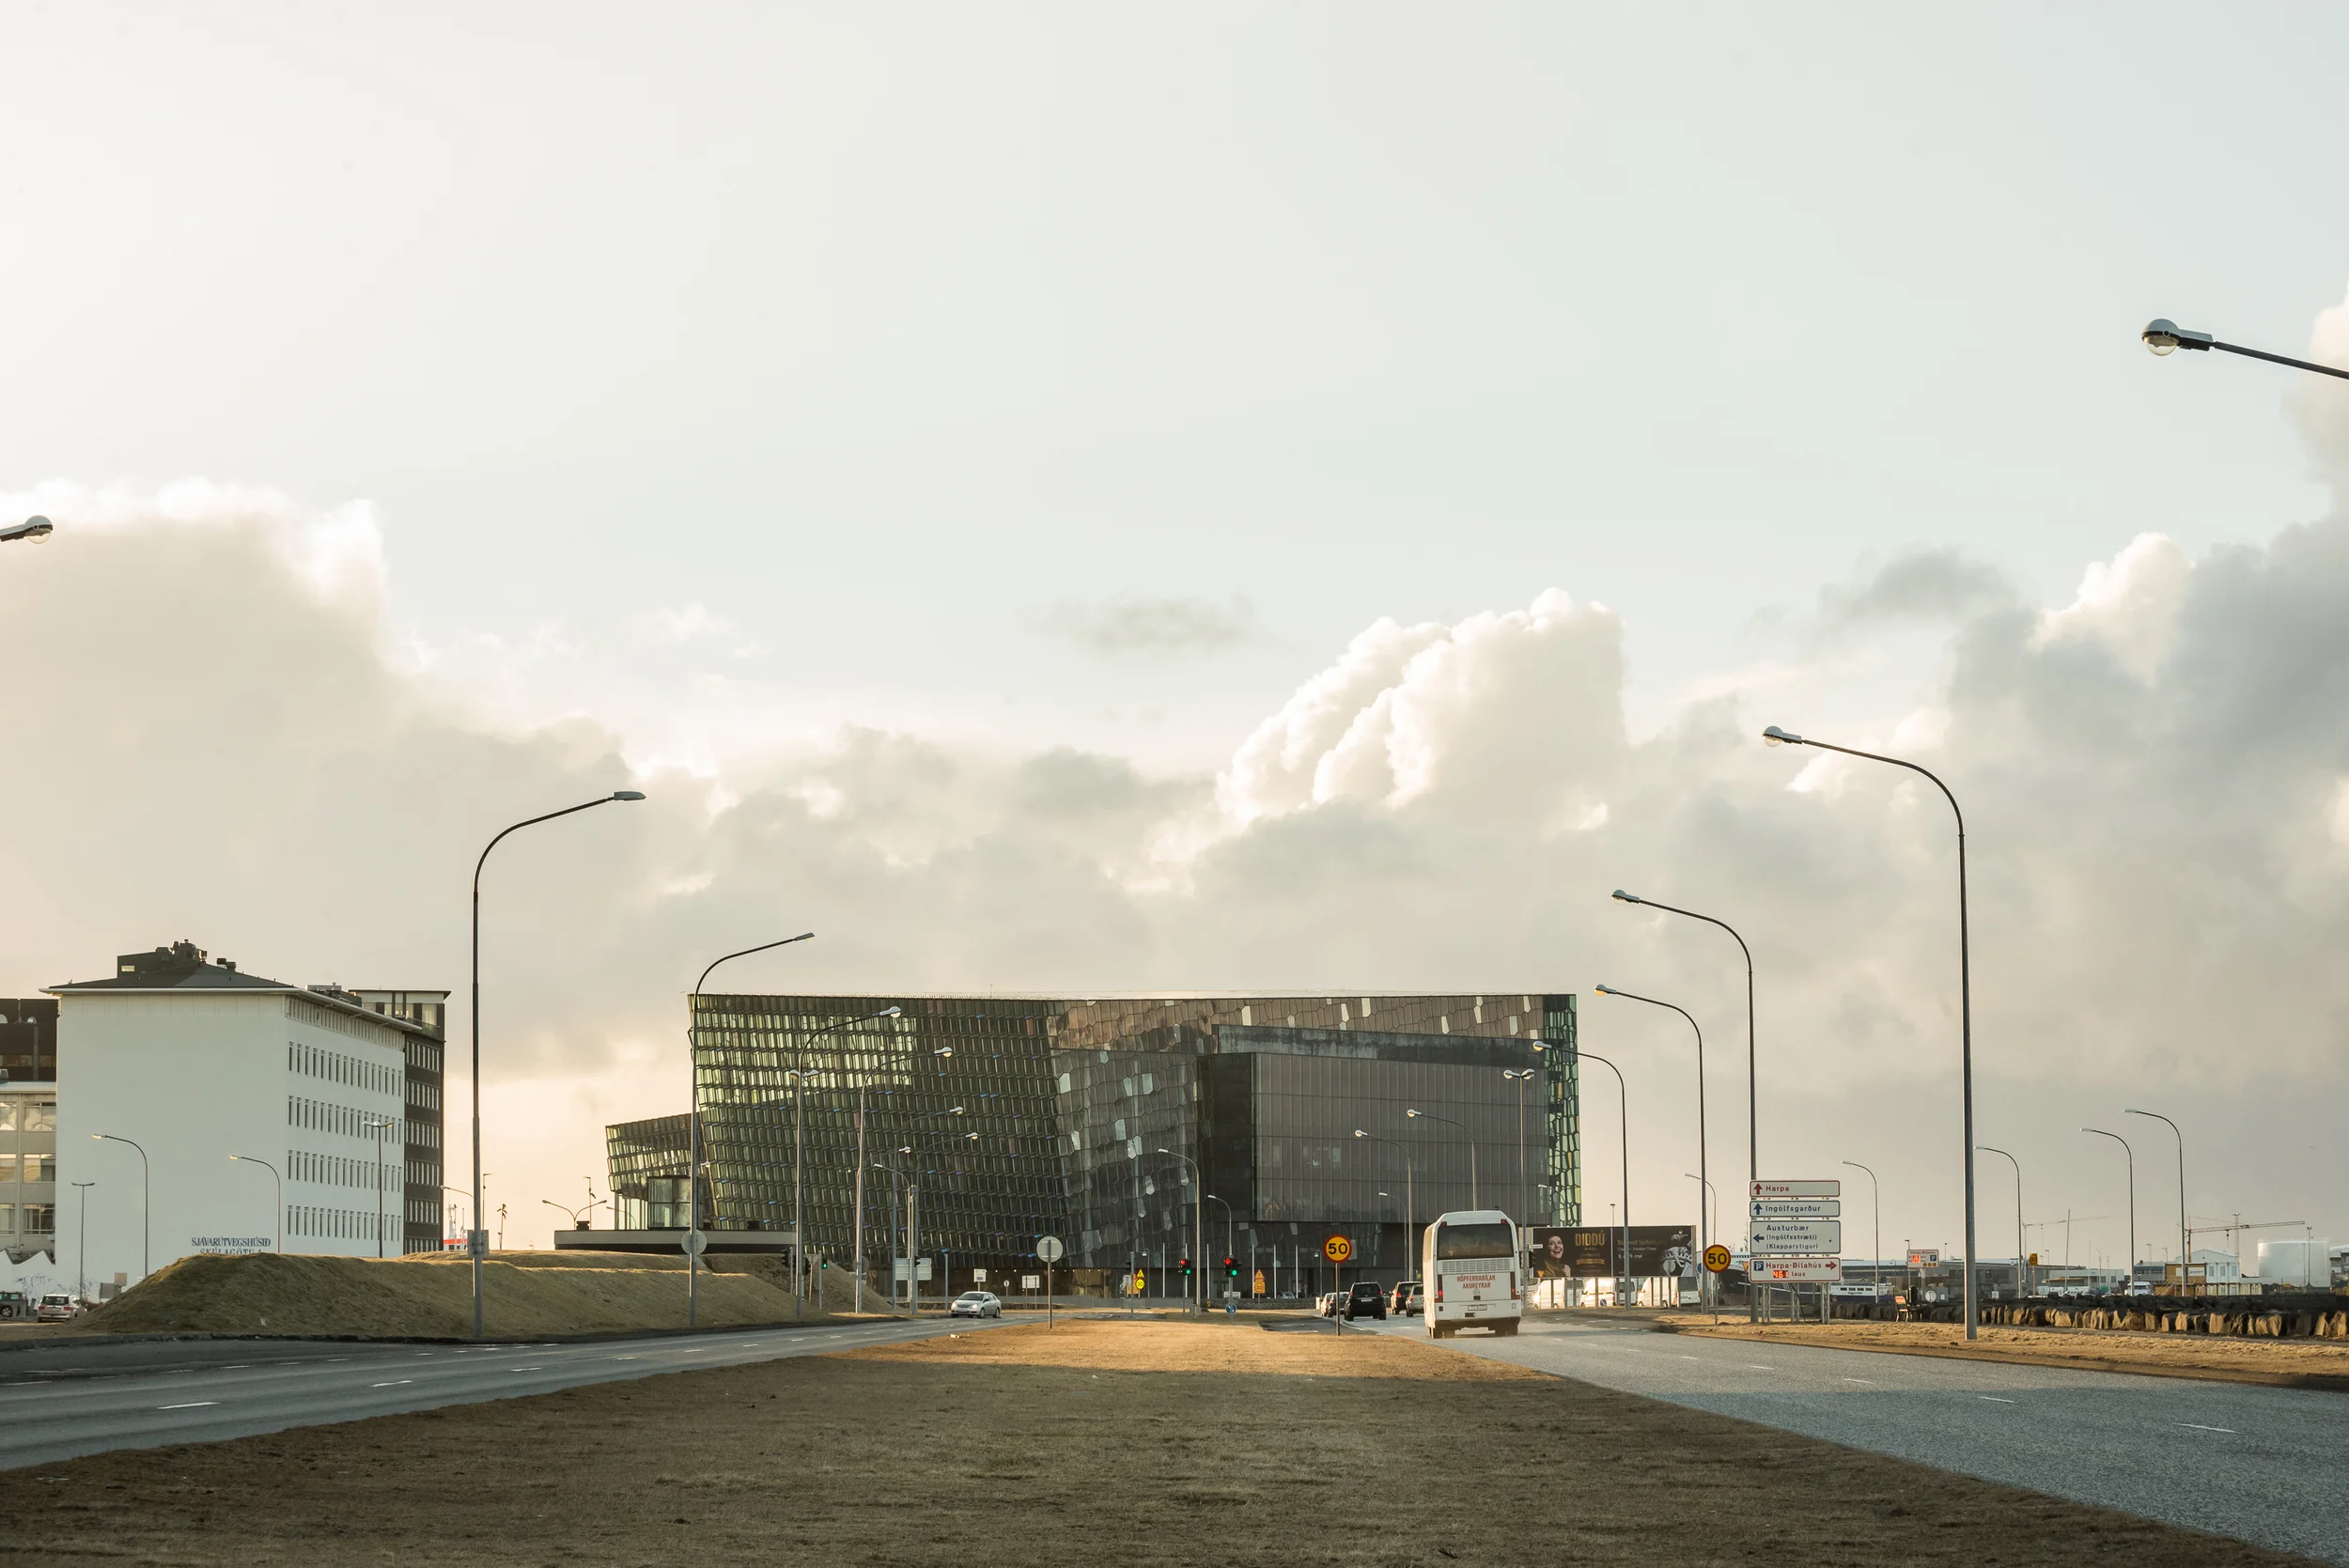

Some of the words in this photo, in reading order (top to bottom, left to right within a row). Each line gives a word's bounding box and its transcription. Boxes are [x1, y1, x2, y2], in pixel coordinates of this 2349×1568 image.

[1575, 1230, 1605, 1246] DIDDÚ
[1328, 1243, 1348, 1255] 50
[1707, 1253, 1728, 1265] 50
[1772, 1270, 1789, 1279] 461
